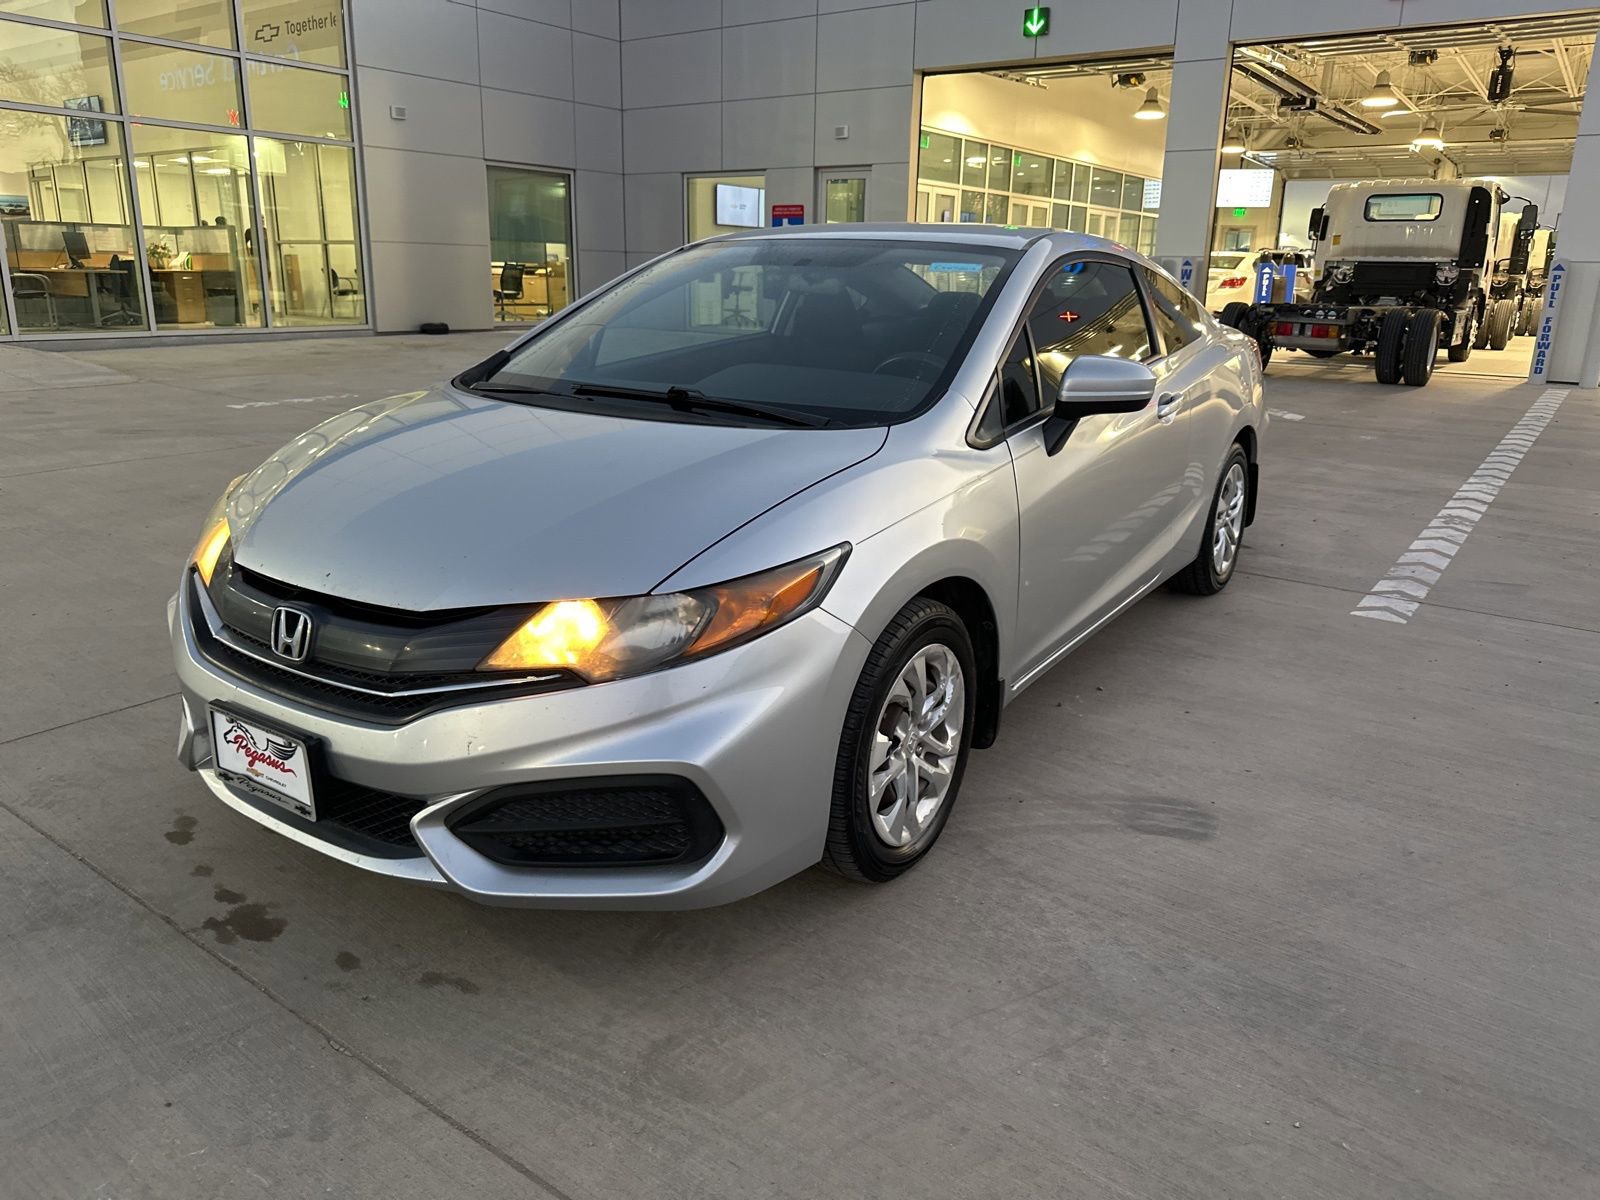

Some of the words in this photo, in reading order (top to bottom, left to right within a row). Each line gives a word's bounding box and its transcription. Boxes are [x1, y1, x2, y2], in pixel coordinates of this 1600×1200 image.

[284, 14, 328, 37] Together
[1548, 274, 1562, 308] PULL
[1533, 317, 1553, 375] FORWARD
[233, 734, 297, 778] Pegasus
